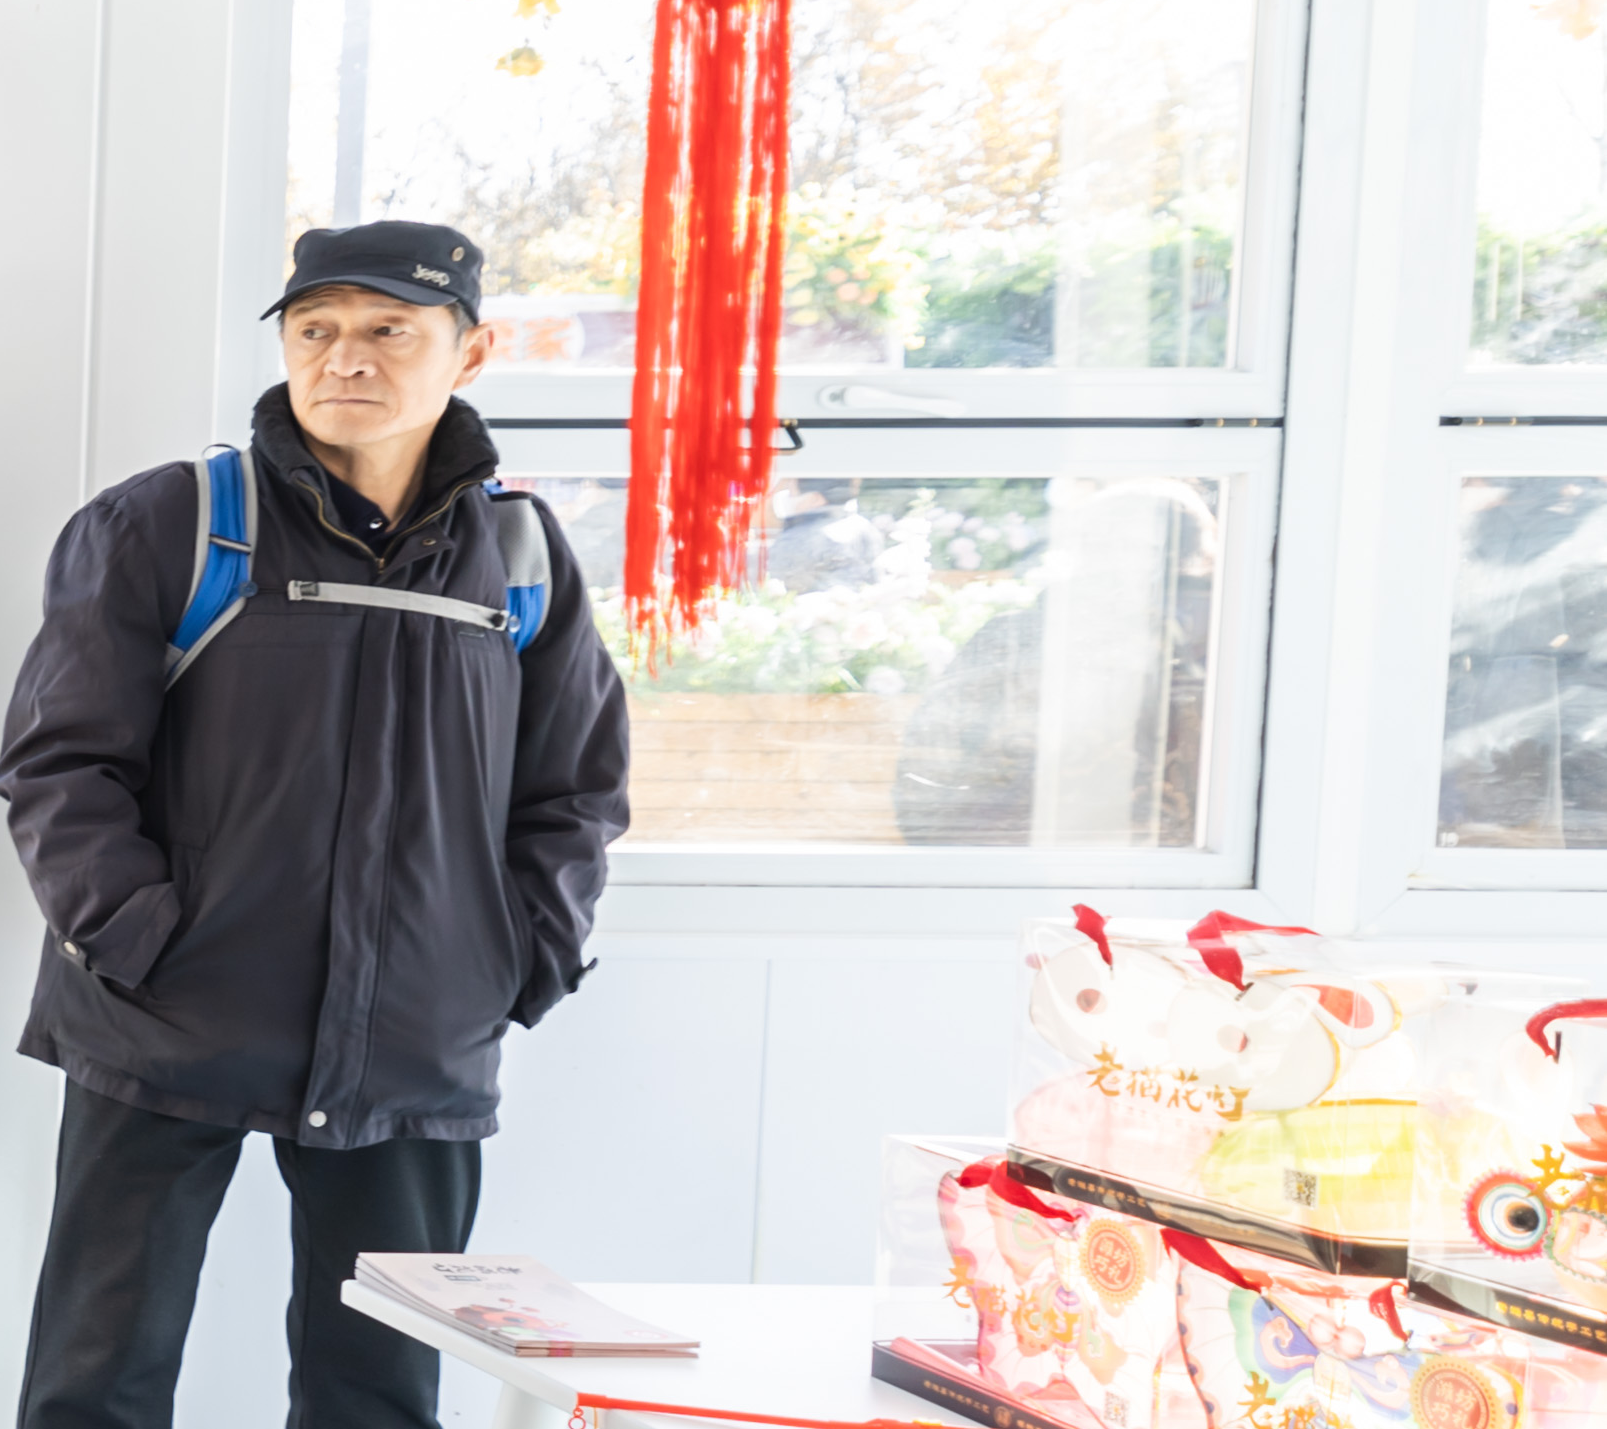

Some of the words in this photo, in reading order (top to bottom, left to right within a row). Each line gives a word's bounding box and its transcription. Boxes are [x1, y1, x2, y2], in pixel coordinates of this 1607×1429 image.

[411, 263, 451, 287] Jeep
[1086, 1040, 1252, 1122] 老猫花灯
